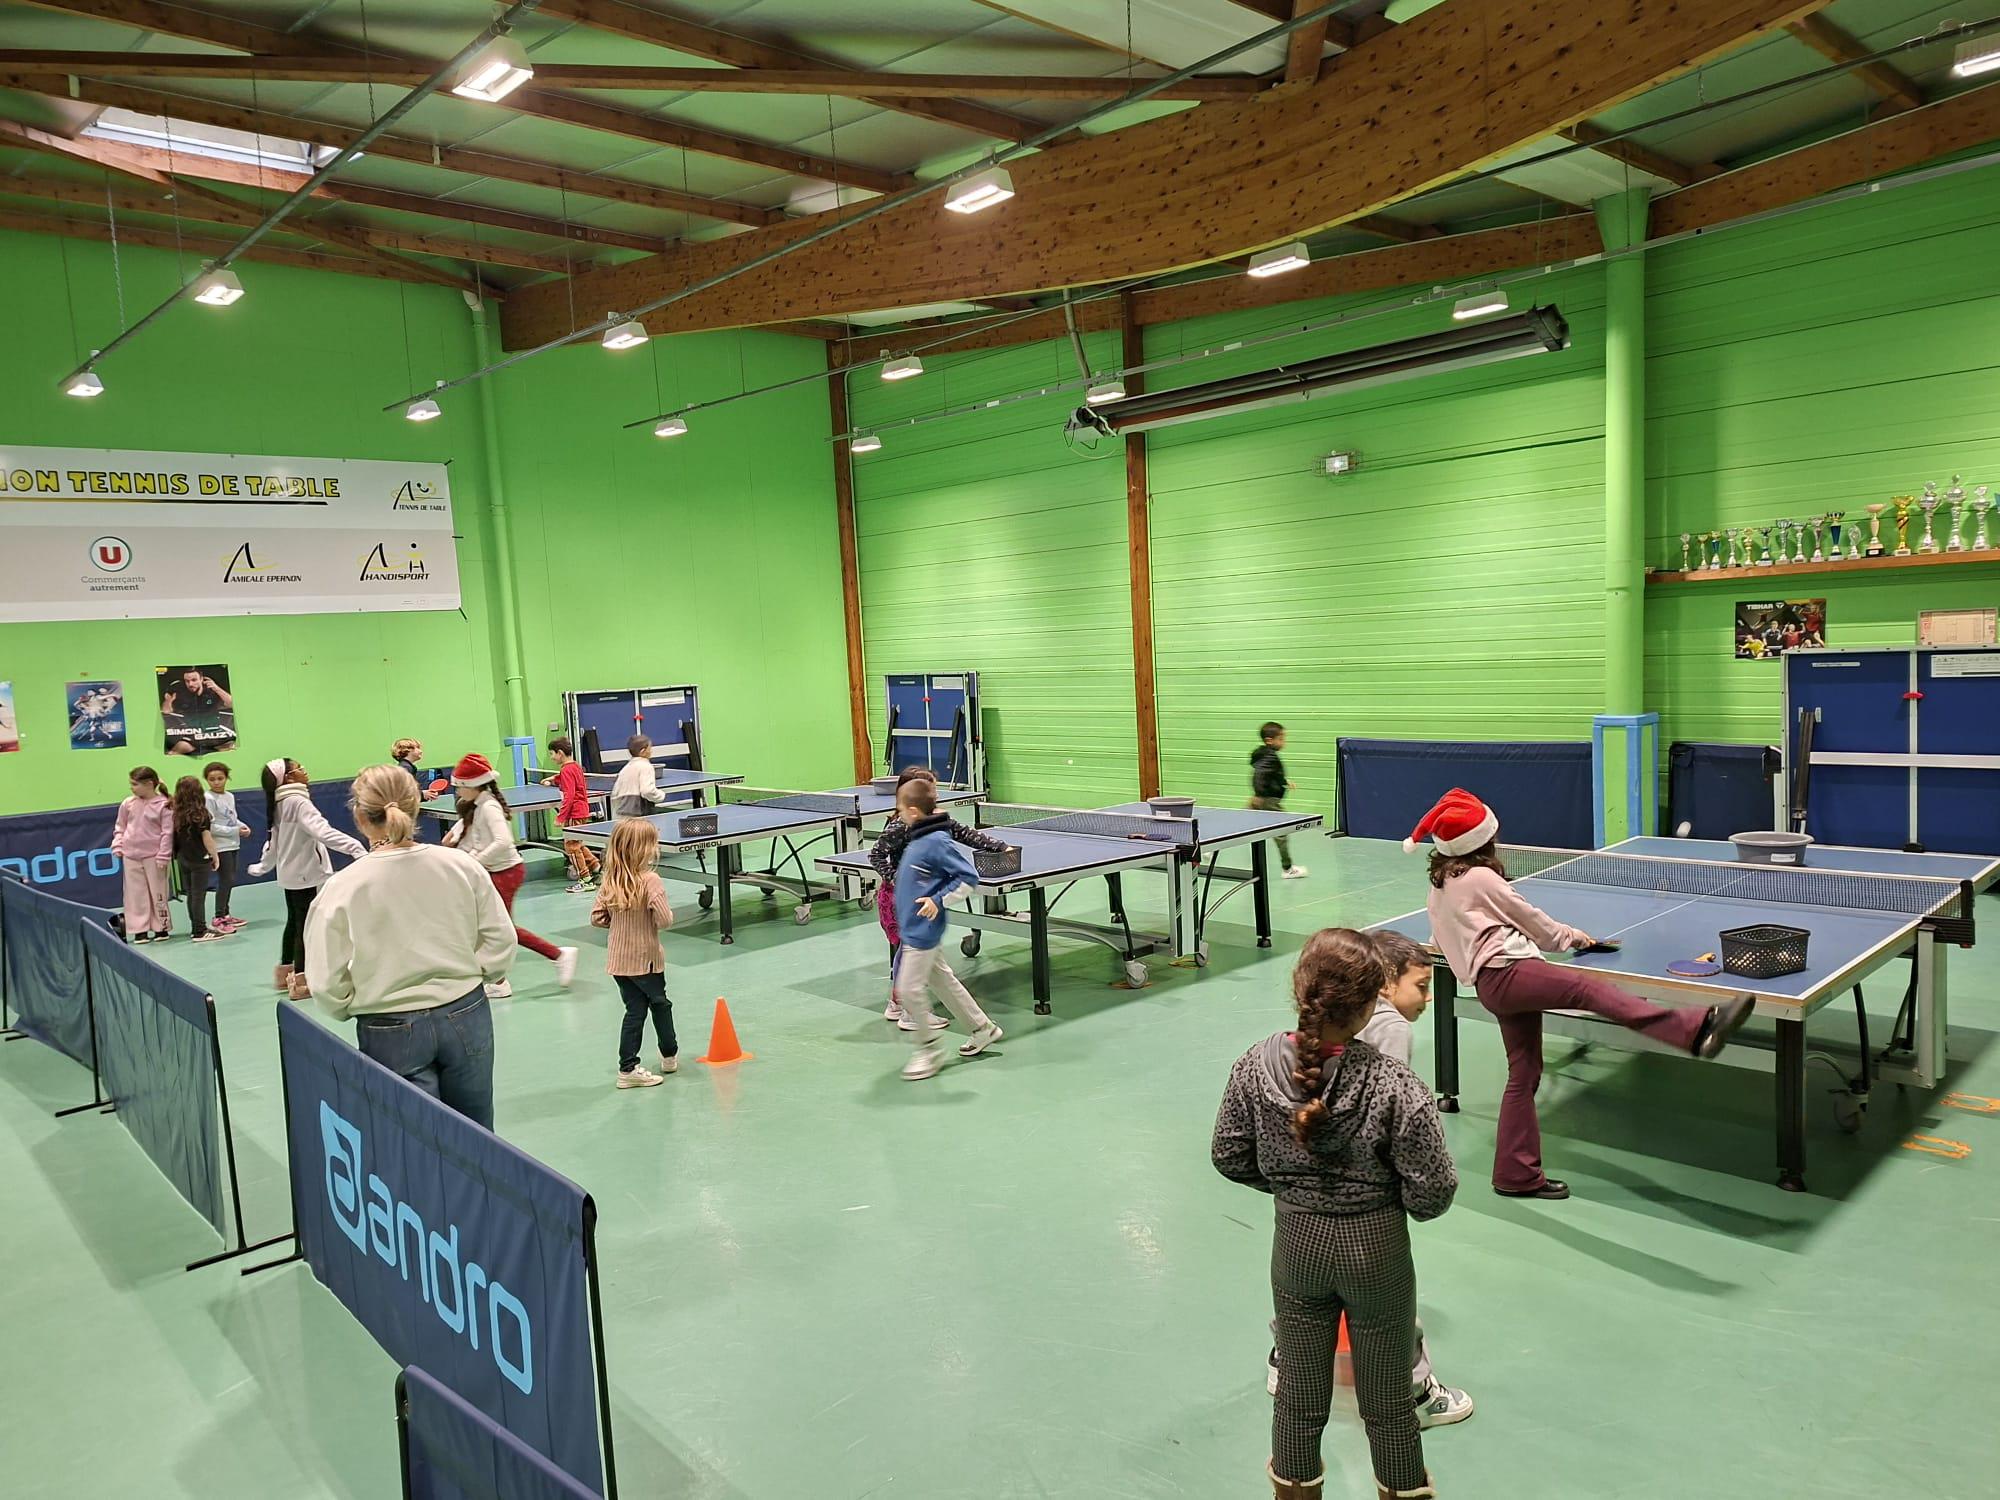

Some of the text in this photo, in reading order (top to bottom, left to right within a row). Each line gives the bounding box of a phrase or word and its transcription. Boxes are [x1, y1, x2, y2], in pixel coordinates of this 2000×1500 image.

[67, 471, 189, 495] TENNIS
[199, 475, 239, 496] DE
[245, 476, 340, 497] TABLE
[80, 576, 146, 584] Commerçants
[231, 575, 302, 583] AMICALE EPERNON
[166, 728, 202, 736] SIMON
